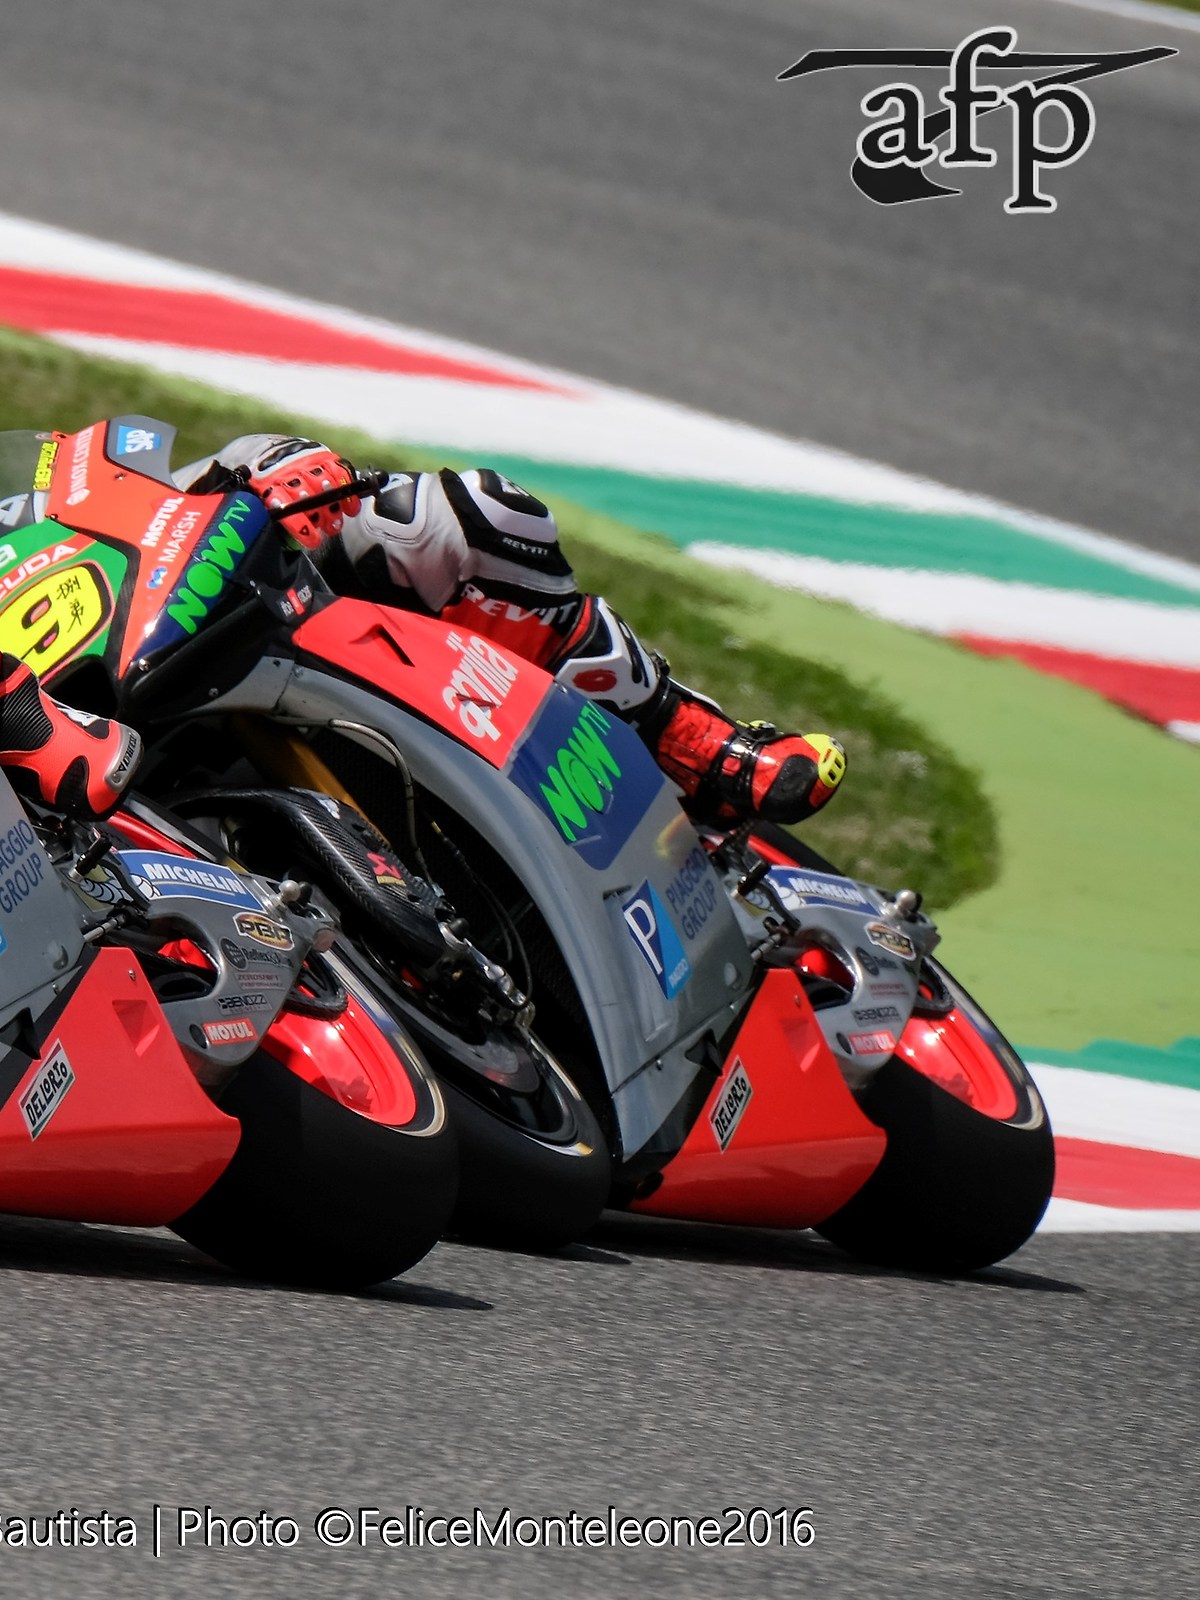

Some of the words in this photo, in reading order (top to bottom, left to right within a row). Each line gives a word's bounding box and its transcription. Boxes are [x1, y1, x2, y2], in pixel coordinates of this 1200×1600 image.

[141, 496, 185, 547] MOTUL
[159, 511, 201, 563] MARSH
[167, 521, 247, 635] NOW
[223, 499, 252, 523] TV
[442, 631, 519, 741] aprilia
[540, 715, 622, 843] NOW
[582, 699, 612, 736] TV
[142, 863, 248, 896] MICHELIN
[665, 847, 708, 915] PIAGGIO
[788, 876, 867, 905] MICHELIN
[623, 898, 663, 975] P
[681, 879, 718, 940] GROUP
[208, 1021, 254, 1041] MOTUL
[853, 1032, 896, 1052] MOTUL
